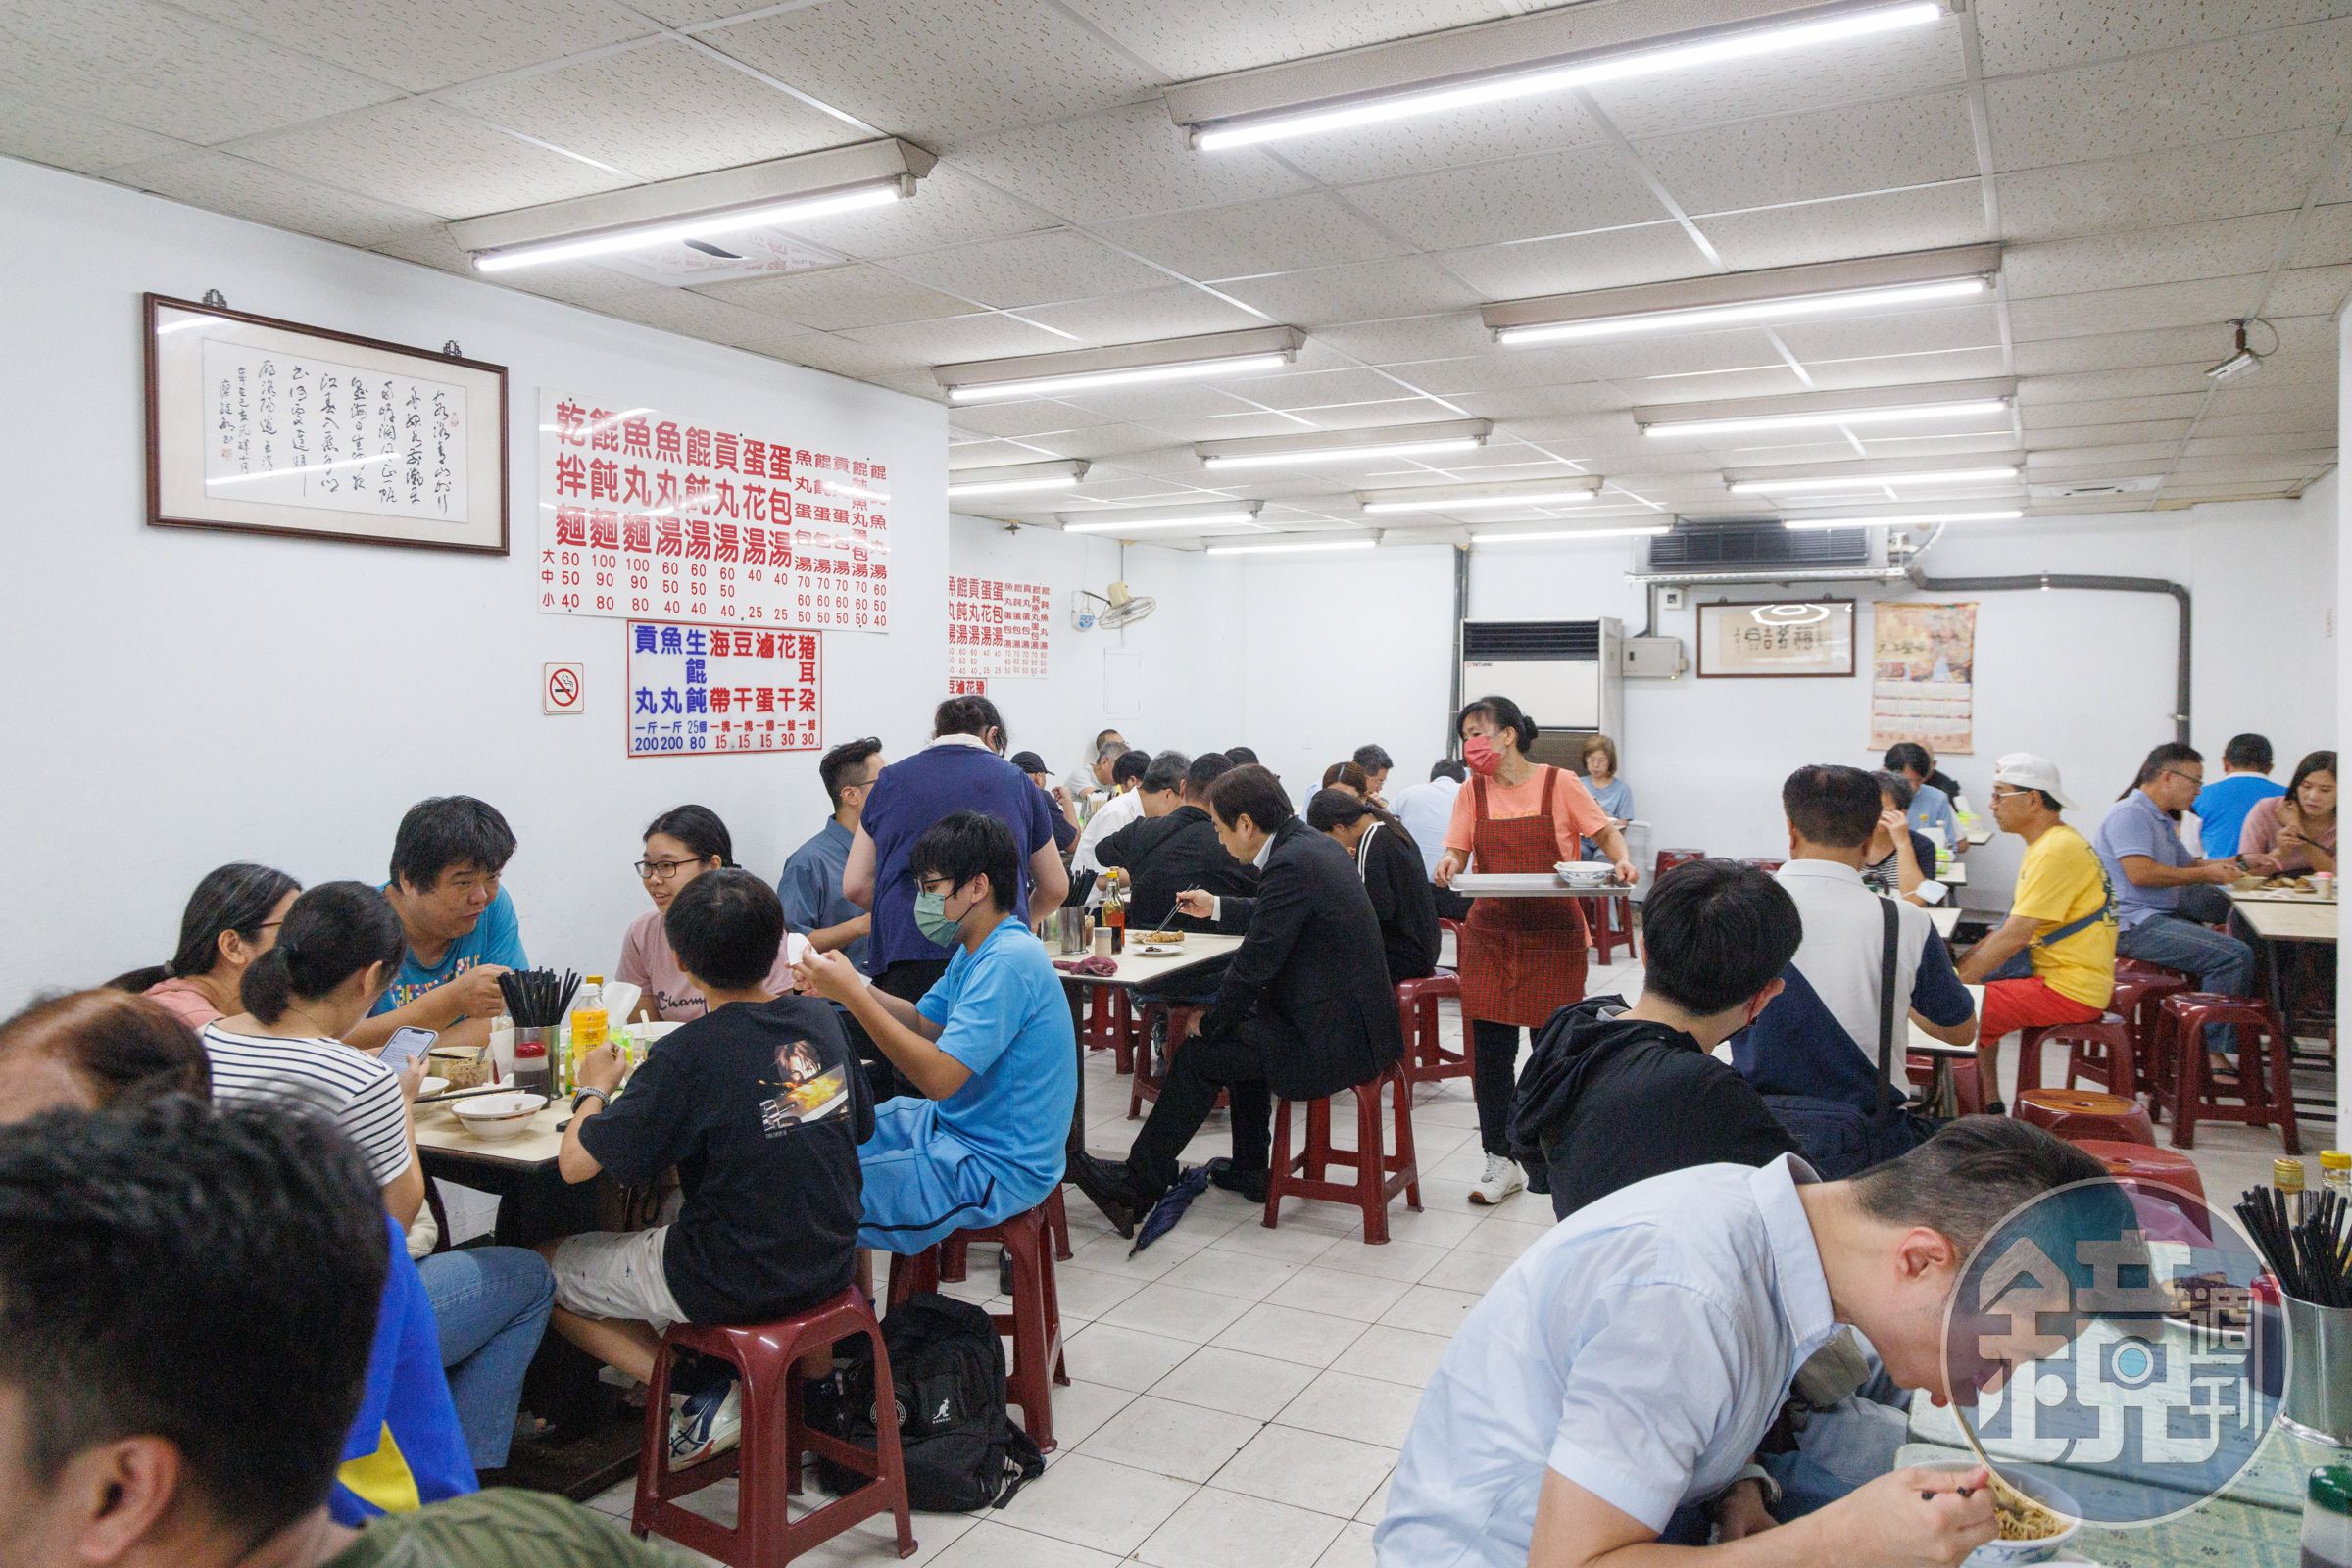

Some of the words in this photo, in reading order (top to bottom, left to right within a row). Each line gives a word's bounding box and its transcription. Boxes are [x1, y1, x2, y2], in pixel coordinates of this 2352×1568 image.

[555, 400, 587, 548] 乾拌麵
[589, 406, 620, 552] 餛飩麵
[621, 413, 653, 556] 魚丸麵
[654, 419, 683, 559] 魚丸湯
[684, 425, 712, 562] 餛飩湯
[713, 430, 741, 564] 貢丸湯
[742, 437, 767, 567] 蛋花湯
[768, 442, 793, 569] 蛋包湯
[794, 447, 813, 573] 魚丸蛋包湯
[832, 454, 851, 577] 貢蛋包湯
[869, 463, 888, 581] 餛魚丸湯
[541, 570, 554, 583] 中
[560, 570, 580, 585] 50
[596, 572, 614, 588] 90
[630, 575, 647, 591] 90
[662, 579, 678, 595] 50
[691, 579, 706, 596] 50
[721, 584, 736, 598] 50
[798, 594, 811, 607] 60
[817, 595, 829, 606] 60
[837, 596, 847, 608] 60
[855, 599, 867, 611] 60
[874, 600, 886, 612] 50
[543, 550, 556, 563] 大
[561, 551, 580, 566] 60
[593, 553, 616, 569] 100
[626, 558, 650, 572] 100
[662, 562, 679, 575] 60
[691, 564, 706, 579] 60
[719, 567, 736, 580] 60
[748, 569, 762, 580] 40
[773, 572, 789, 584] 40
[799, 576, 809, 588] 70
[818, 578, 829, 588] 70
[837, 580, 848, 591] 70
[857, 581, 866, 593] 70
[873, 584, 885, 596] 60
[544, 593, 555, 608] 小
[561, 594, 580, 609] 40
[596, 596, 614, 611] 80
[632, 597, 650, 612] 80
[665, 600, 680, 614] 40
[691, 602, 706, 615] 40
[721, 604, 735, 616] 40
[748, 605, 762, 618] 25
[775, 609, 787, 621] 25
[798, 612, 810, 624] 50
[817, 612, 830, 622] 50
[836, 612, 849, 623] 50
[855, 614, 867, 624] 50
[873, 615, 886, 625] 40
[635, 722, 657, 734] 一斤
[661, 721, 682, 733] 一斤
[685, 629, 707, 714] 生餛飩
[710, 629, 730, 713] 海帶
[733, 631, 753, 713] 豆干
[777, 634, 796, 712] 花干
[635, 737, 659, 750] 200
[661, 736, 683, 749] 200
[690, 736, 706, 749] 80
[715, 735, 727, 748] 15
[738, 734, 750, 748] 15
[760, 734, 772, 747] 15
[781, 733, 795, 745] 30
[802, 732, 814, 745] 30
